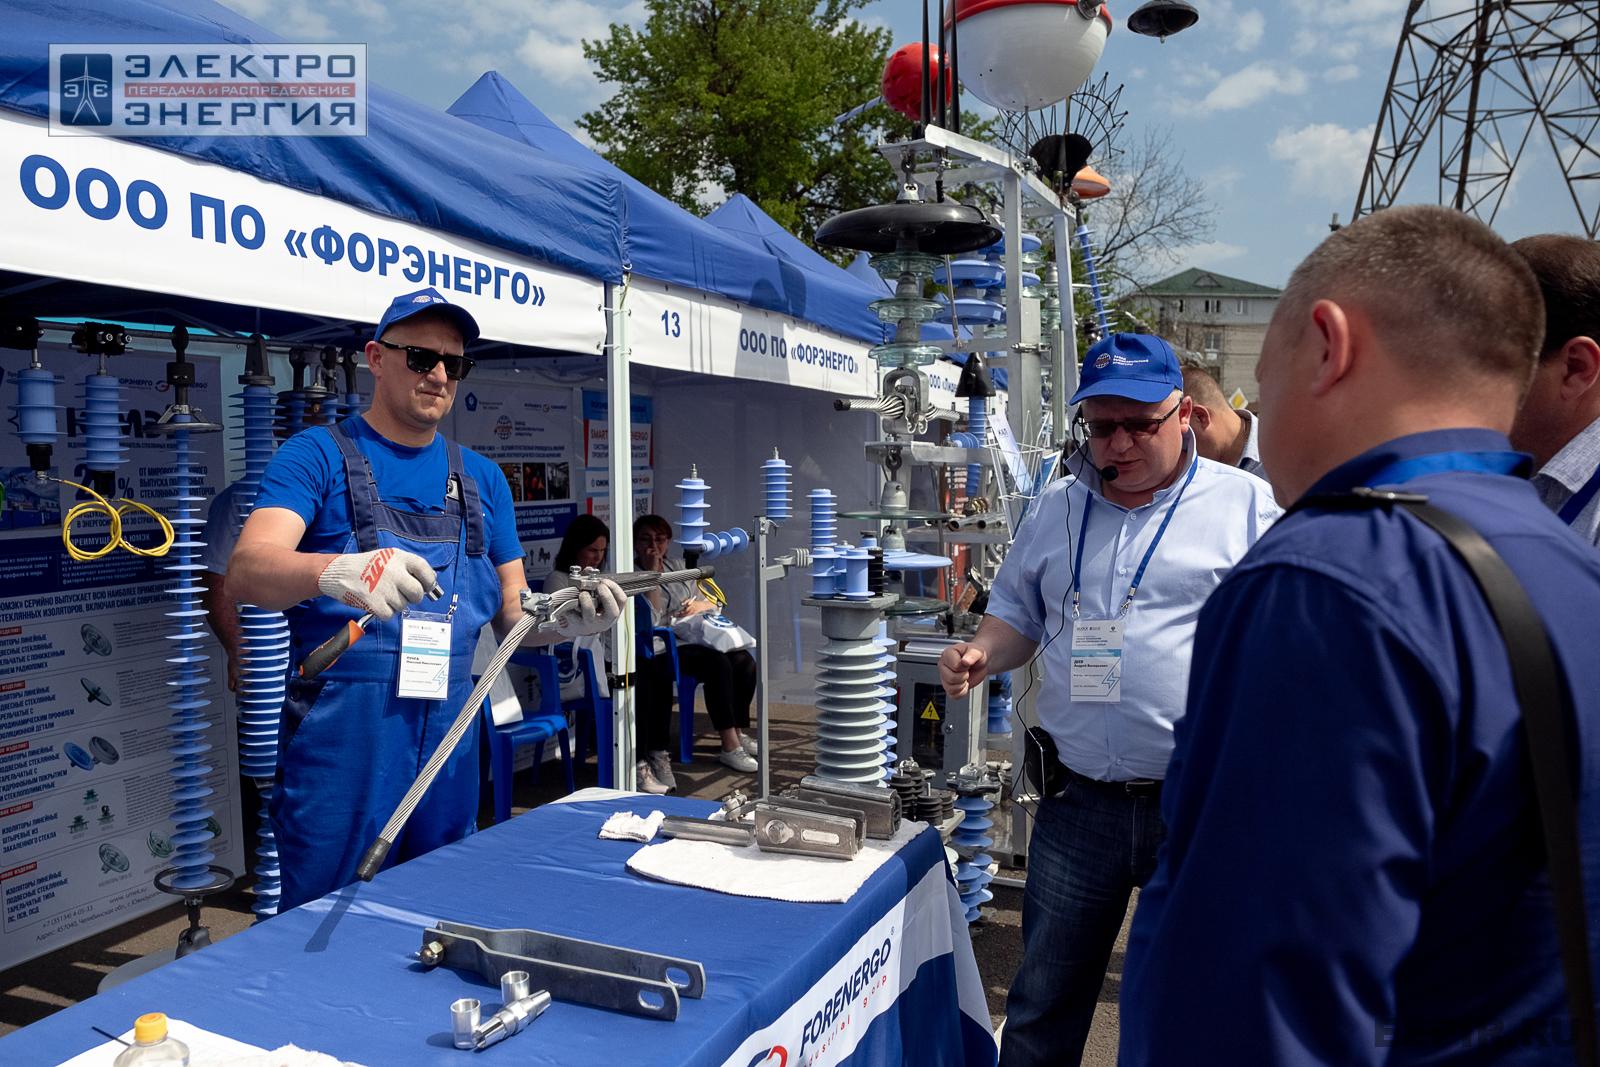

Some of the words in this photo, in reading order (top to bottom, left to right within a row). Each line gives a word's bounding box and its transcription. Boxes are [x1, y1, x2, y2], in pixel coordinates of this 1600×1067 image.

[19, 154, 168, 230] ООО
[189, 191, 266, 250] ПО
[284, 224, 546, 307] «ФОРЭНЕРГО»
[661, 309, 681, 338] 13
[740, 328, 767, 356] ООО
[770, 335, 787, 359] ПО
[790, 342, 859, 374] «ФОРЭНЕРГО»
[929, 374, 941, 389] ООО
[800, 938, 891, 1058] FORENERGO
